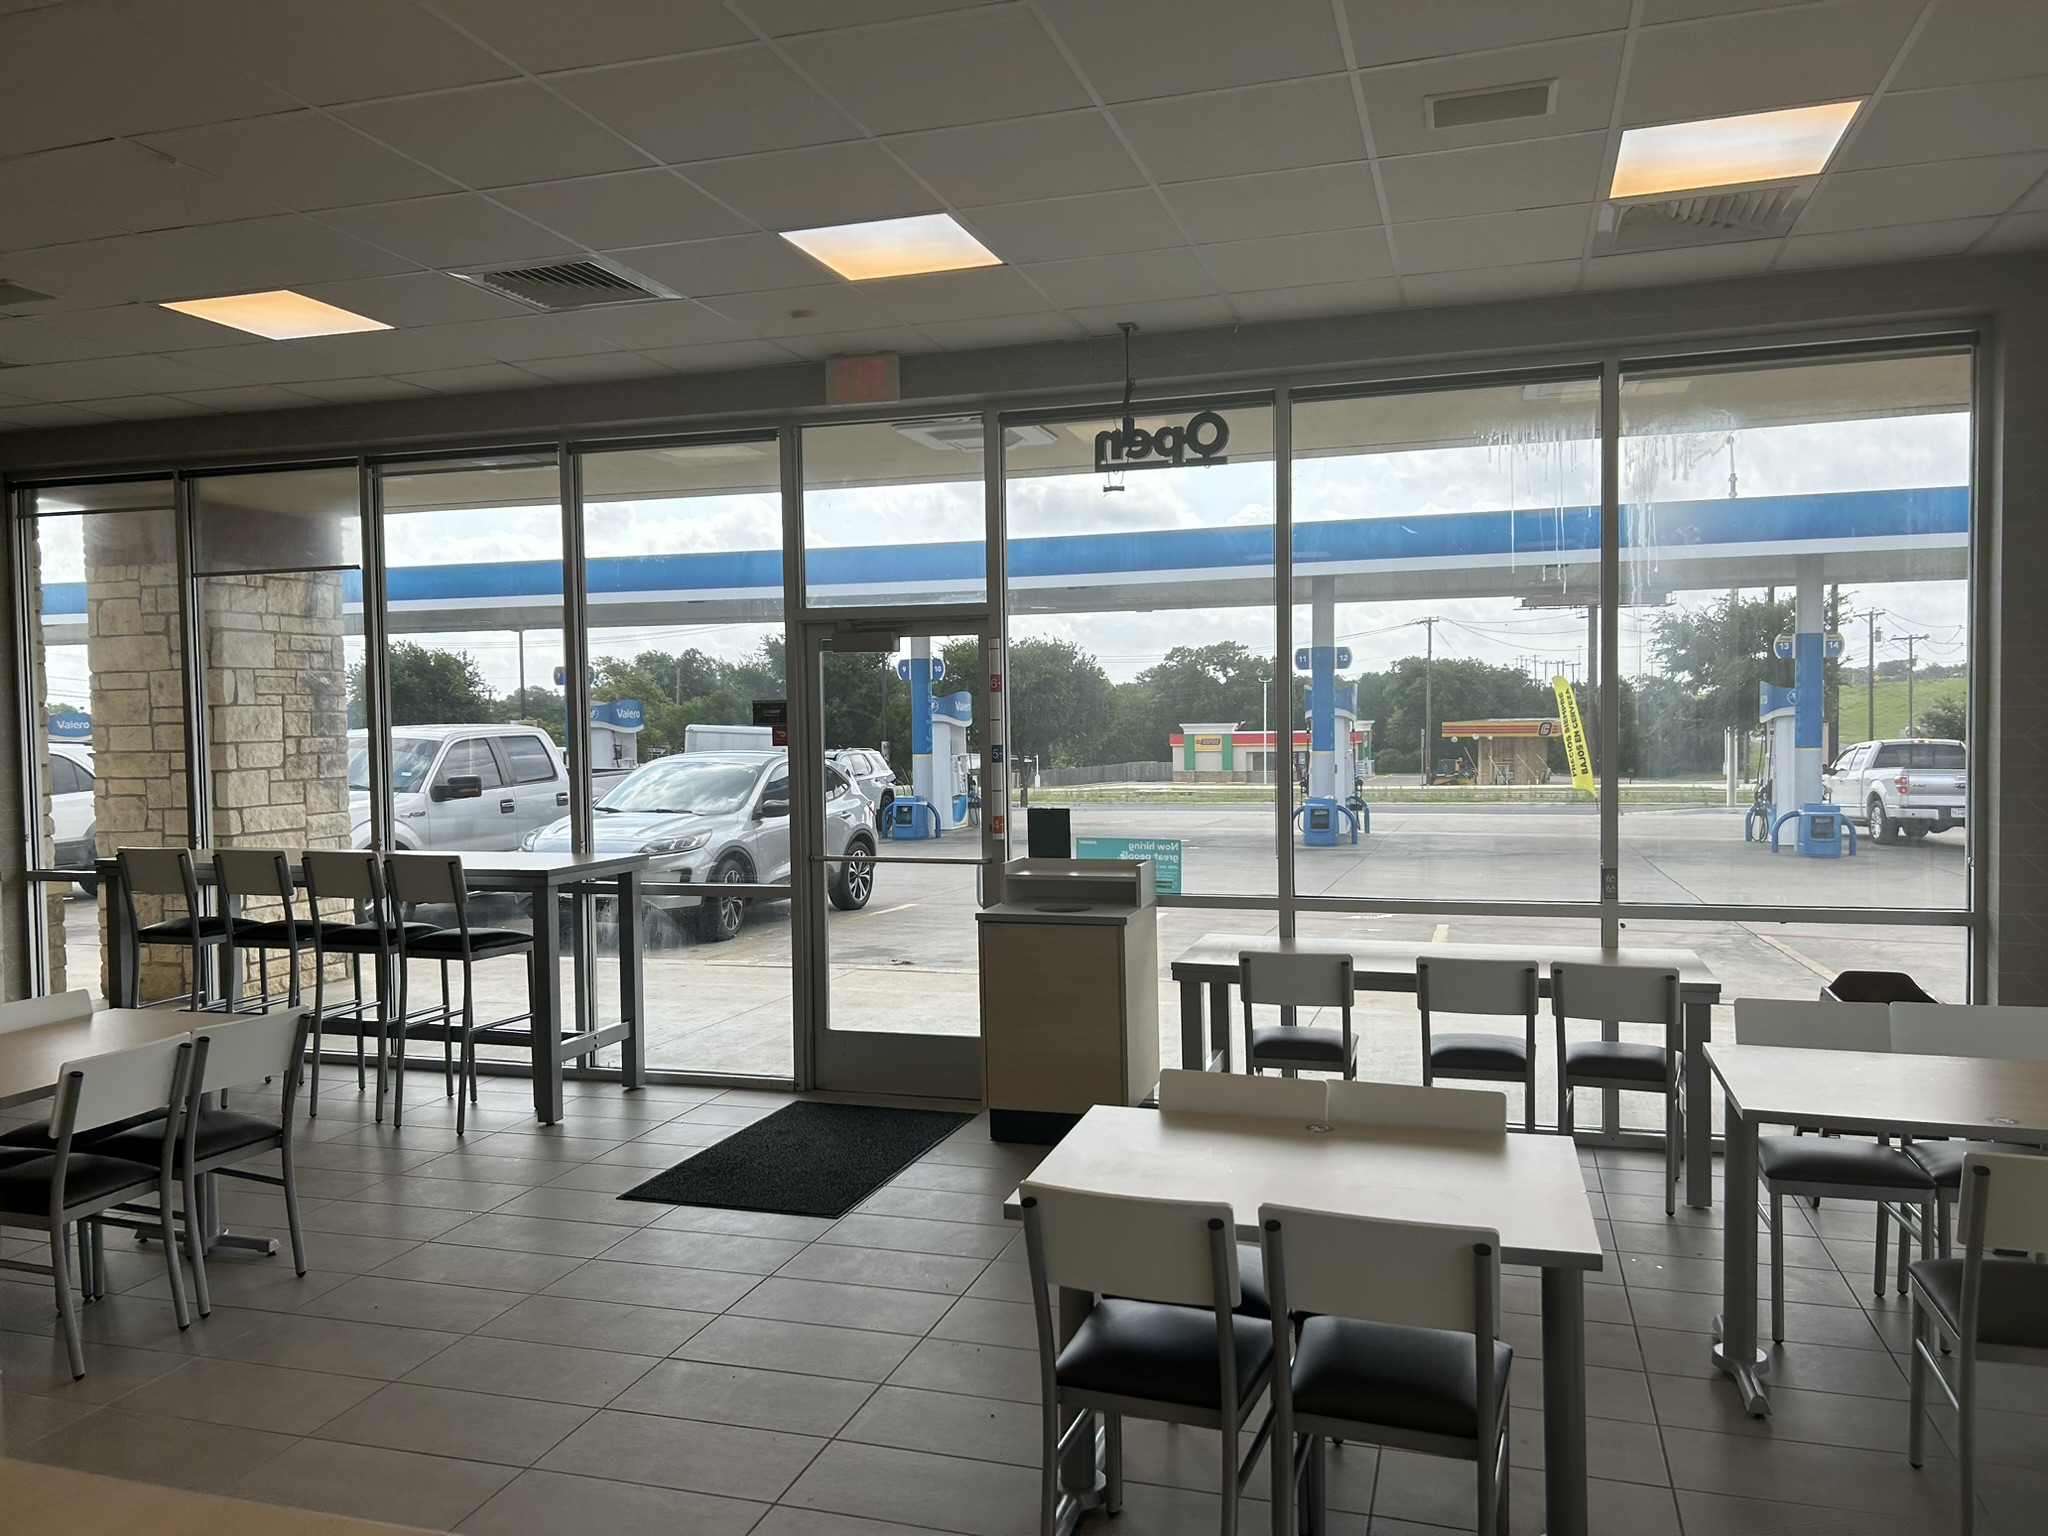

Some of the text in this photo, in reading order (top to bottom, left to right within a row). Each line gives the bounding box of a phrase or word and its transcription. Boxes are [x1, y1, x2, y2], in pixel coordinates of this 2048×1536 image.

[1779, 642, 1790, 650] 13
[1828, 641, 1839, 649] 14
[1298, 655, 1307, 663] 11
[1339, 654, 1349, 662] 12
[616, 708, 640, 719] Valero
[56, 720, 90, 729] Valero
[1558, 692, 1577, 777] PRECIOS SIEMPRE
[1565, 688, 1589, 775] BAJOS EN CERVEZA
